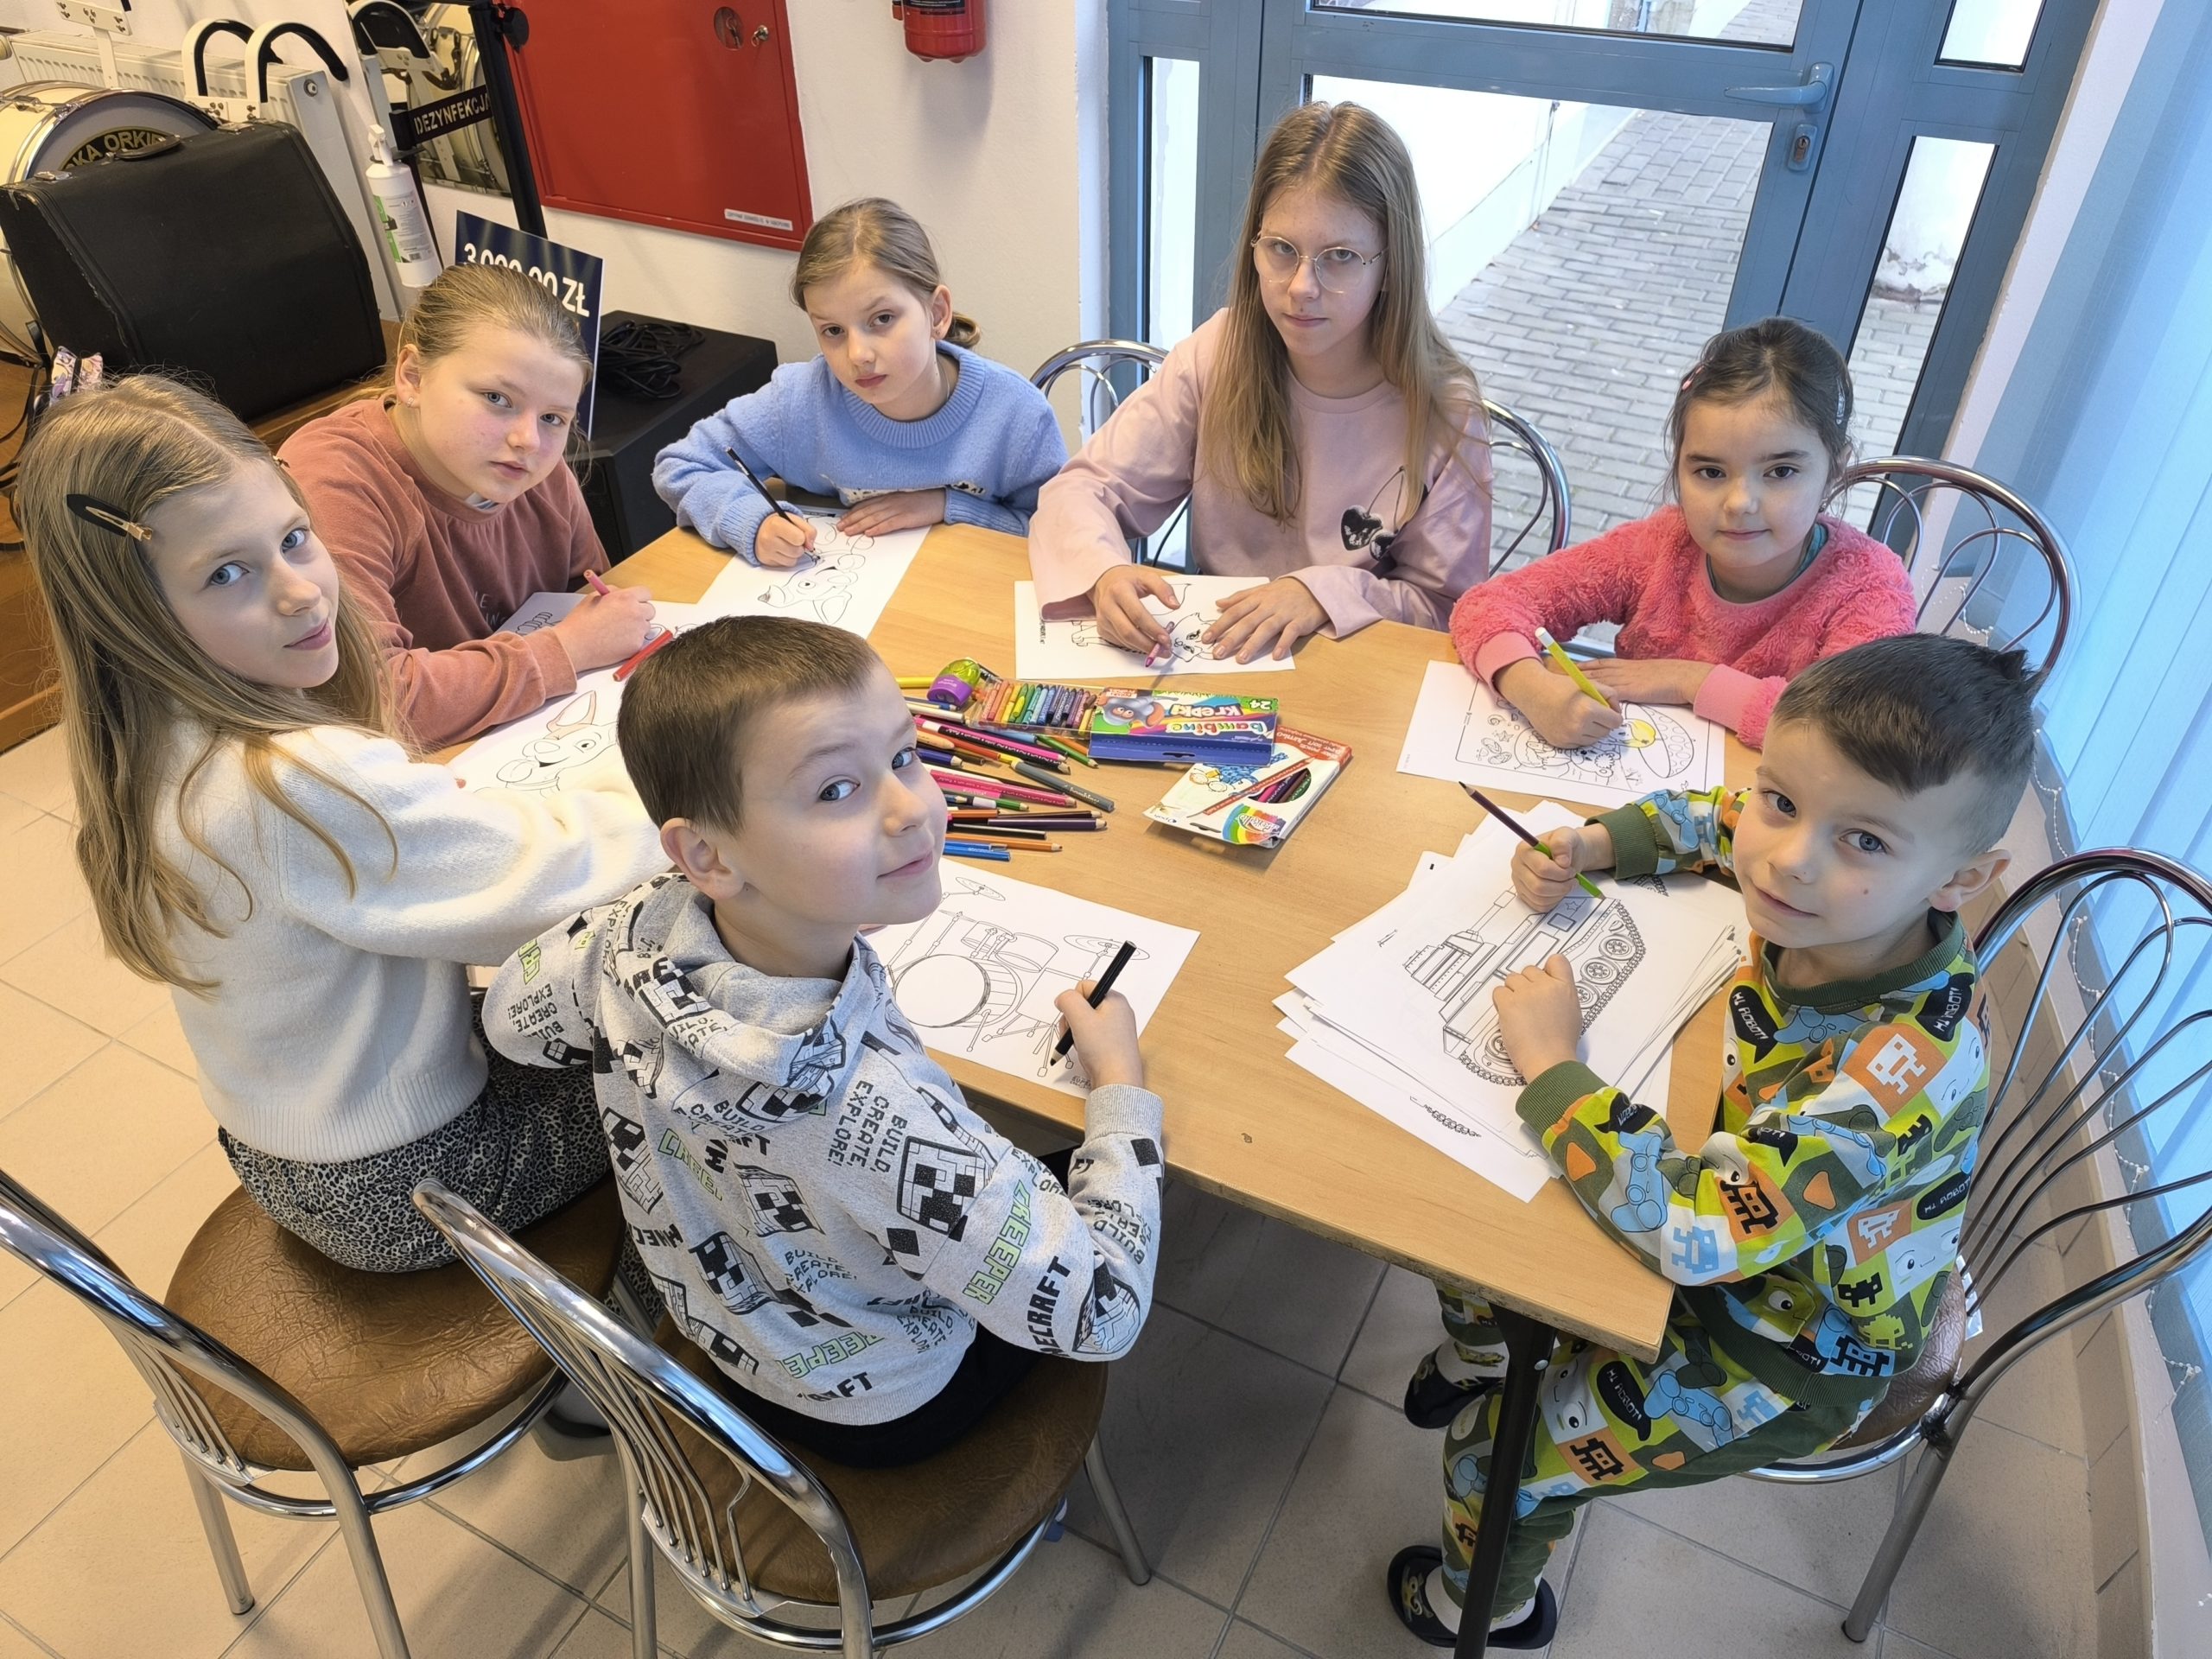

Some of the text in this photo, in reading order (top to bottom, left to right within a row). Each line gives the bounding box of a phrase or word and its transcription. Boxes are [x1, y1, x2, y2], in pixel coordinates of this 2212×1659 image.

[562, 276, 590, 317] ZŁ
[1249, 698, 1273, 710] 24
[1738, 1007, 1769, 1039] ROBOT!
[827, 1080, 874, 1166] EXPLORE!
[846, 1096, 889, 1167] CREATE,
[870, 1115, 908, 1173] BUILD,
[962, 1179, 1032, 1306] CREEPER
